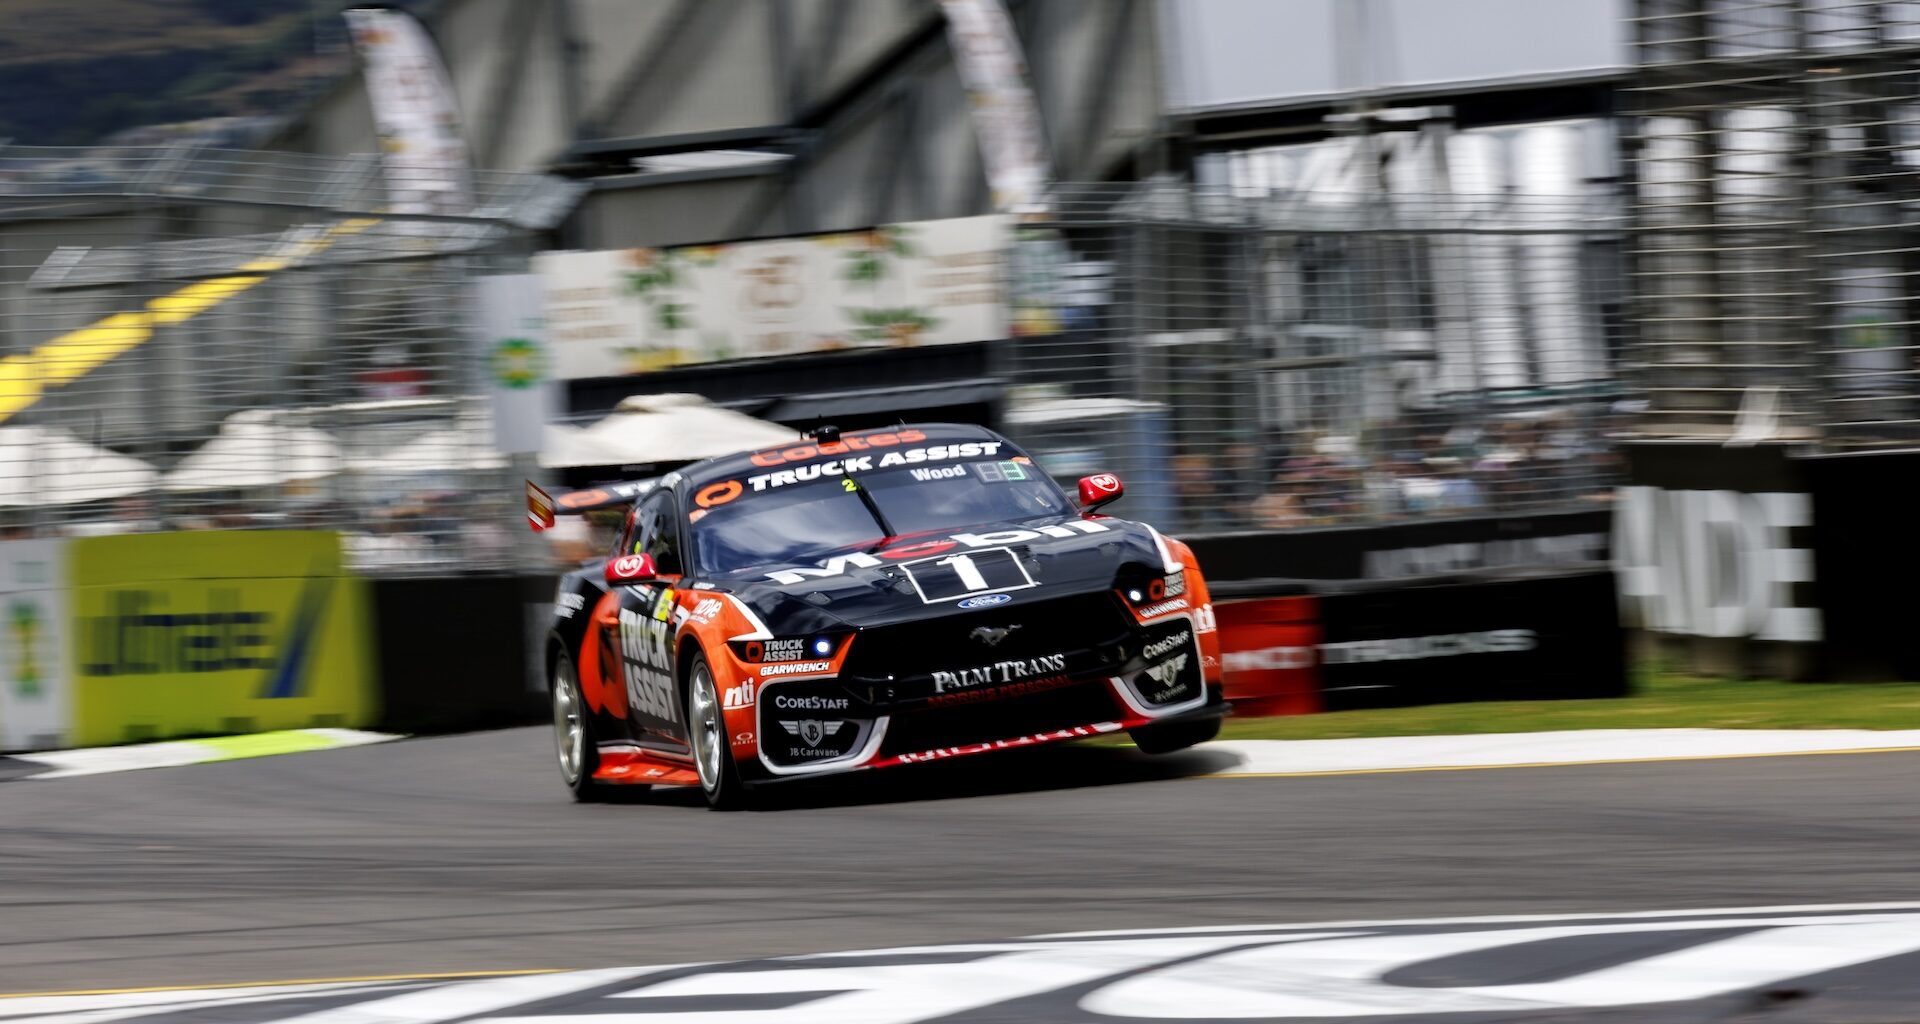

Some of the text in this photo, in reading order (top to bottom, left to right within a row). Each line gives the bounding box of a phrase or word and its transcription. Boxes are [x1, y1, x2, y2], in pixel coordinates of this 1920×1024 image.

[748, 441, 1002, 492] TRUCK ASSIST
[910, 463, 967, 482] Wood
[936, 554, 990, 592] 1
[963, 593, 1008, 608] Ford
[619, 607, 671, 672] TRUCK
[764, 638, 804, 651] TRUCK
[763, 650, 804, 662] ASSIST
[760, 661, 830, 677] GEARWRENCH
[931, 653, 1066, 693] PALM TRANS
[624, 661, 678, 724] ASSIST
[722, 677, 755, 708] nti
[801, 747, 840, 757] Caravans
